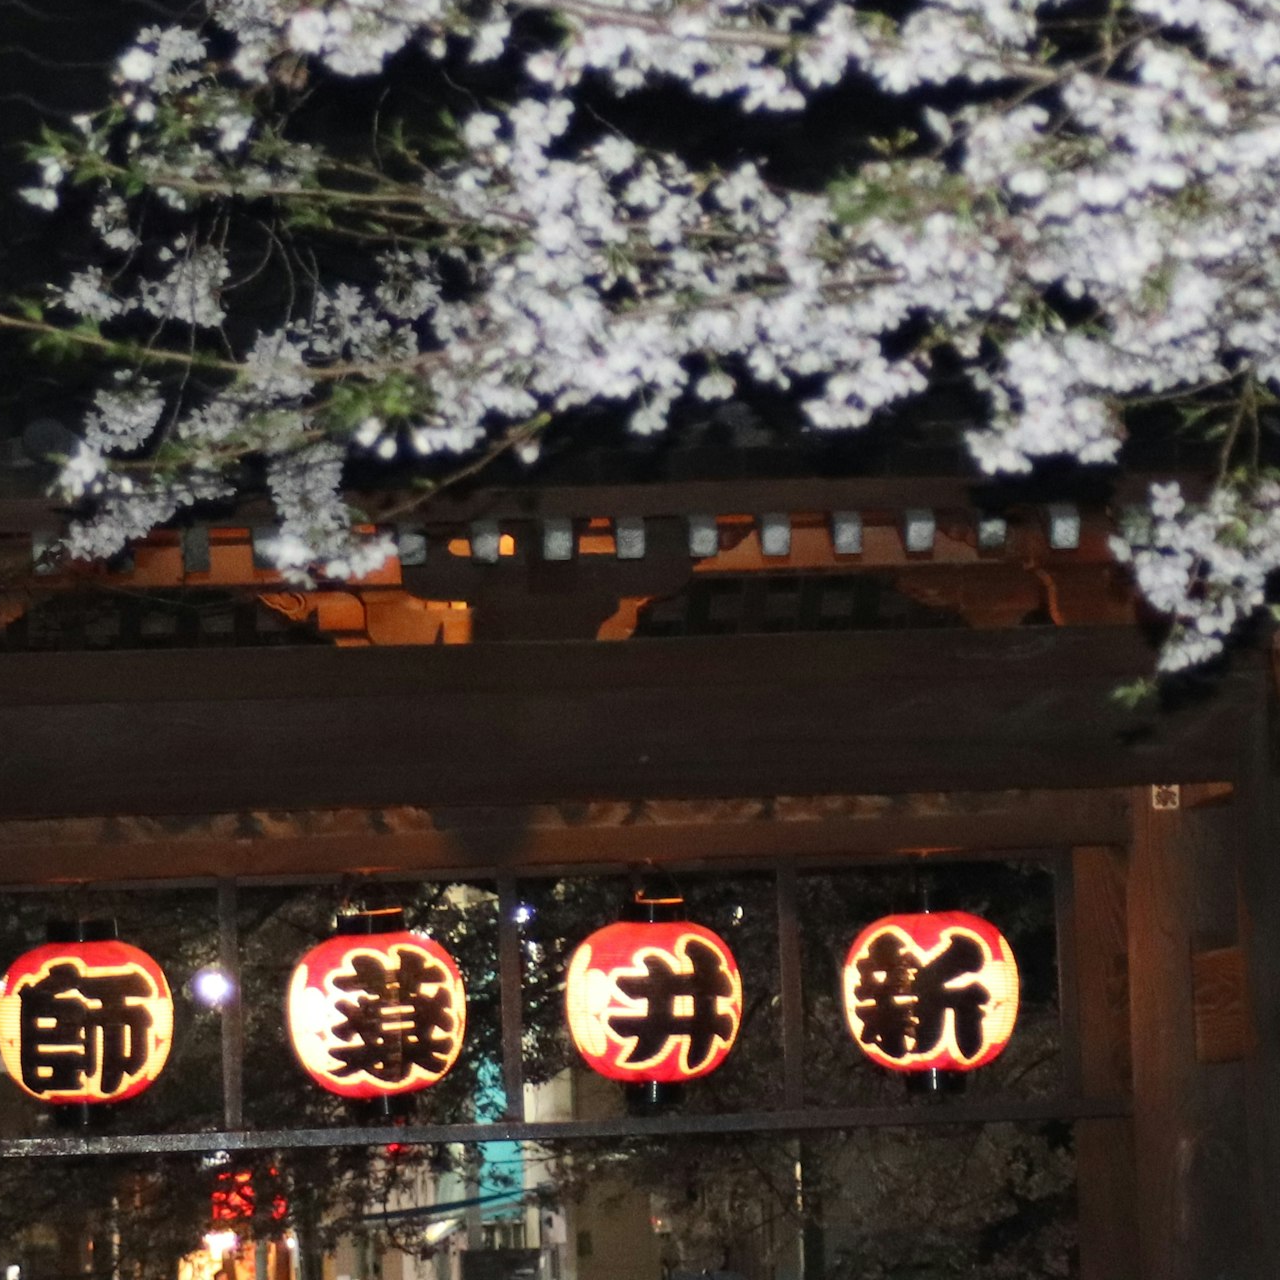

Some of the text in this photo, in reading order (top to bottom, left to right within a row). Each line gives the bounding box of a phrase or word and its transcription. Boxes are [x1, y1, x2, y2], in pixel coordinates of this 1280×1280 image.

[19, 963, 154, 1094] 師
[607, 938, 732, 1068] 井
[854, 931, 991, 1059] 新
